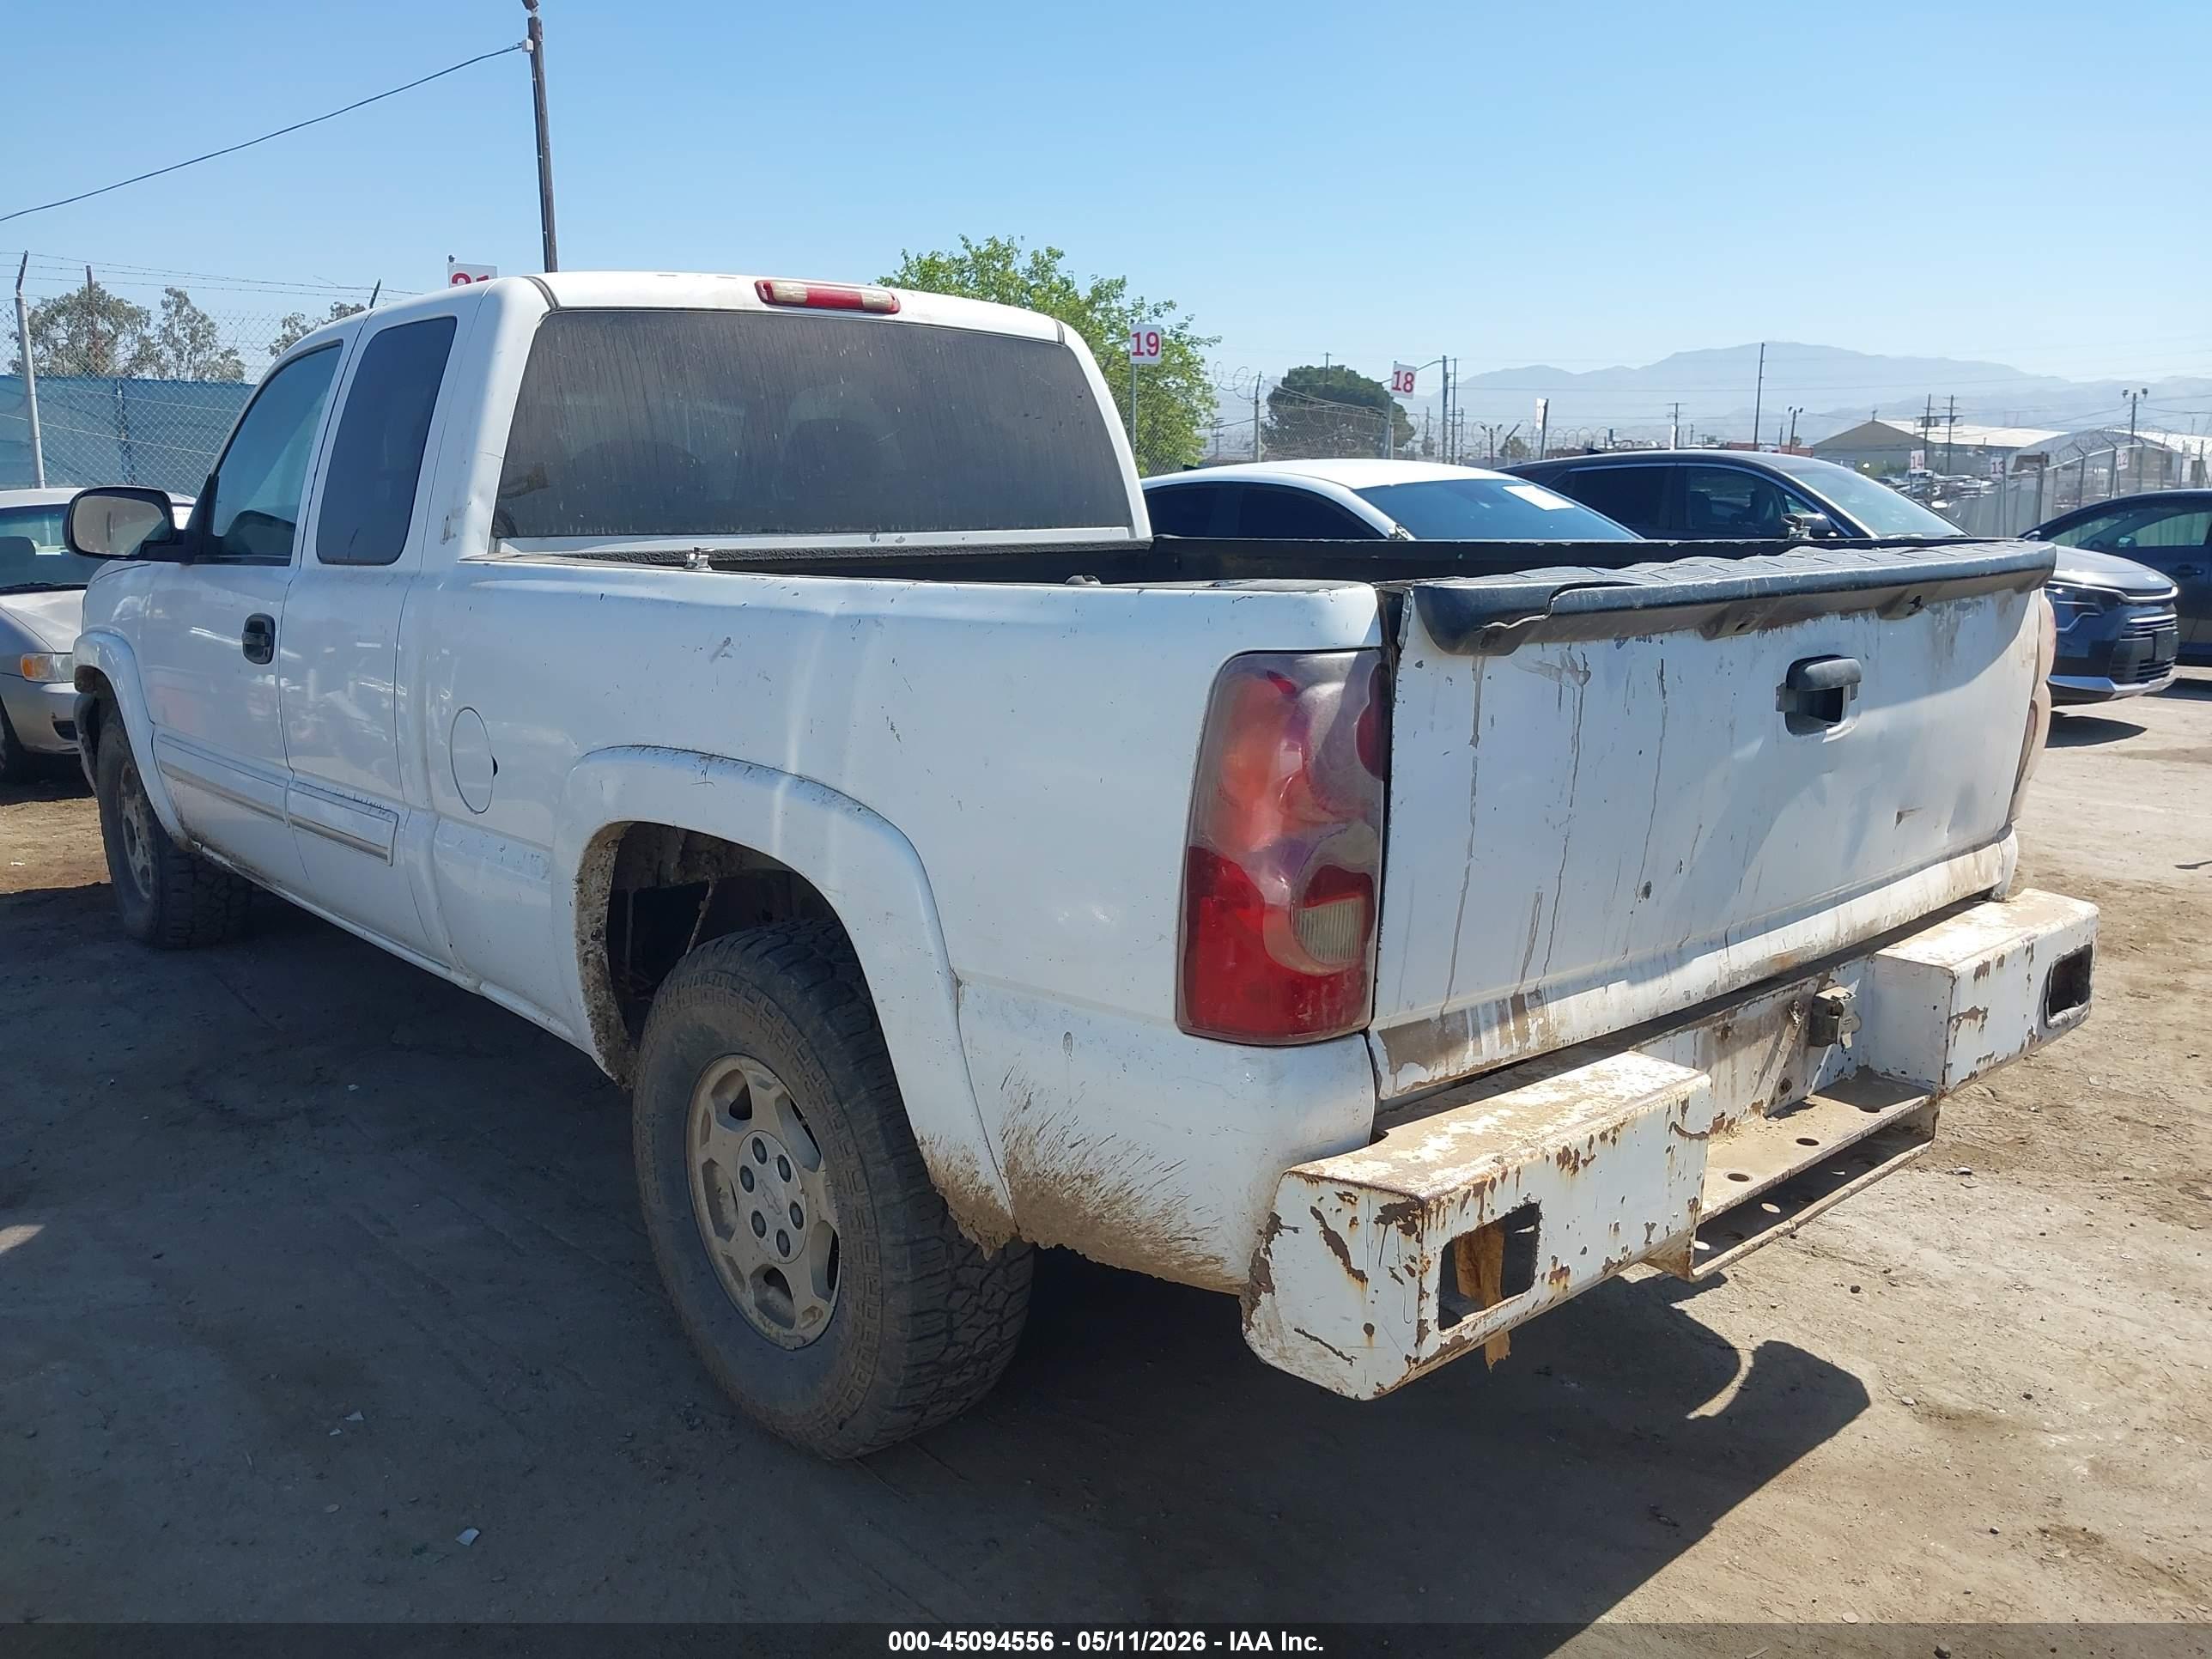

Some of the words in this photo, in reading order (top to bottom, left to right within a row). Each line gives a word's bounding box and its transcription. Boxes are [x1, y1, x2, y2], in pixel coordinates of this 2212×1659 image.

[1131, 331, 1160, 357] 19
[1391, 370, 1415, 393] 18
[1911, 454, 1924, 470] 14
[2118, 453, 2128, 466] 12
[1991, 461, 2006, 475] 13
